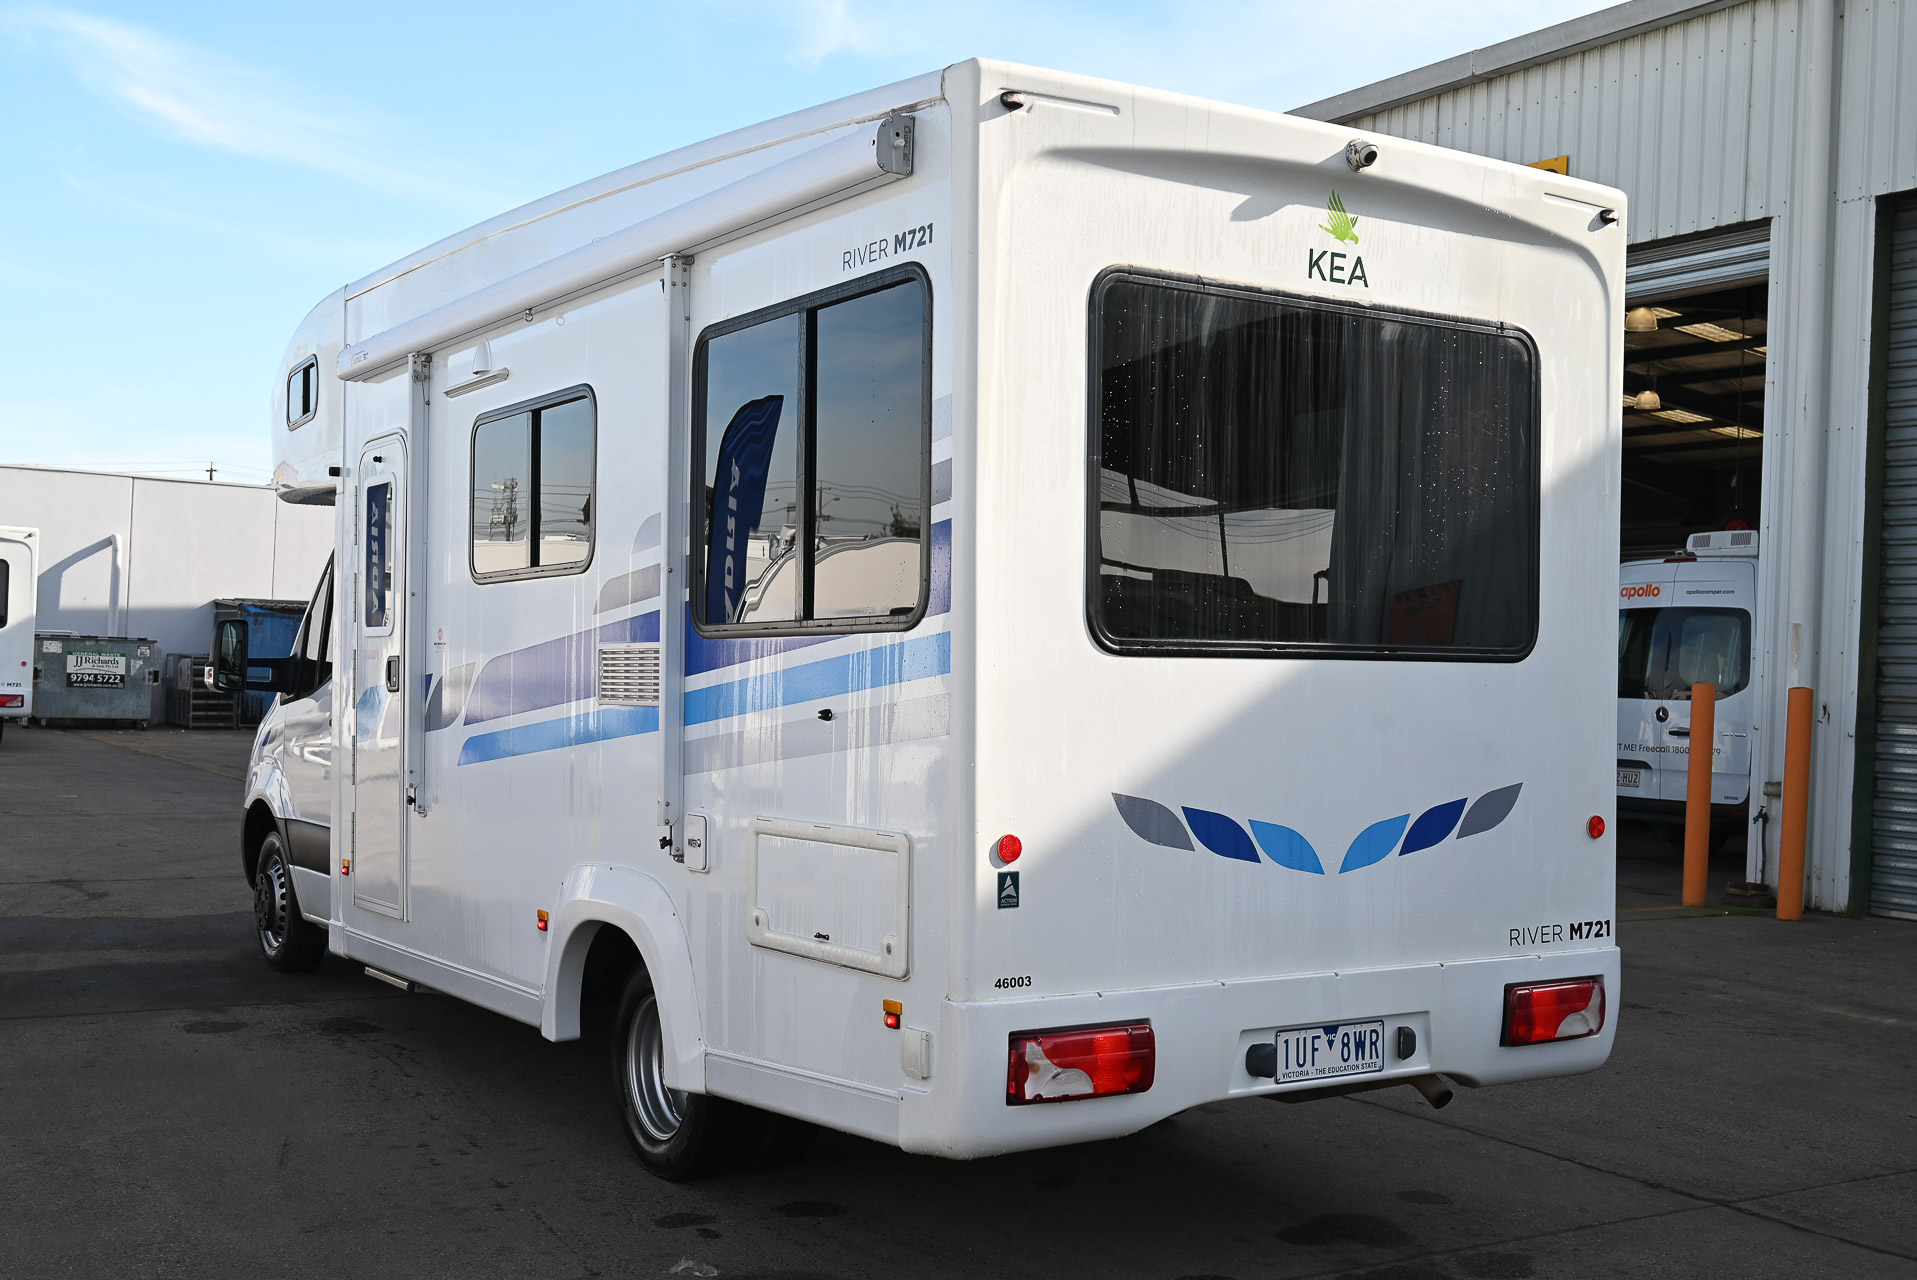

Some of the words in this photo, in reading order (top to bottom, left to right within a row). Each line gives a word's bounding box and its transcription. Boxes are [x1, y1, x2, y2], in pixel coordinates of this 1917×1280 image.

[842, 238, 888, 271] RIVER
[894, 223, 933, 254] M721
[1308, 248, 1369, 288] KEA
[1620, 584, 1661, 600] apollo
[74, 655, 83, 668] JJ
[84, 656, 119, 665] Richards
[70, 673, 94, 682] 9794
[97, 674, 121, 683] 5722
[1623, 743, 1637, 751] ME!
[1639, 744, 1670, 753] Freecall
[1509, 924, 1563, 946] RIVER
[1569, 919, 1610, 940] M721
[994, 976, 1032, 989] 46003
[1283, 1035, 1321, 1070] 1UF
[1341, 1028, 1380, 1062] 8WR
[1282, 1069, 1310, 1079] VICTORIA
[1328, 1064, 1360, 1073] EDUCATION
